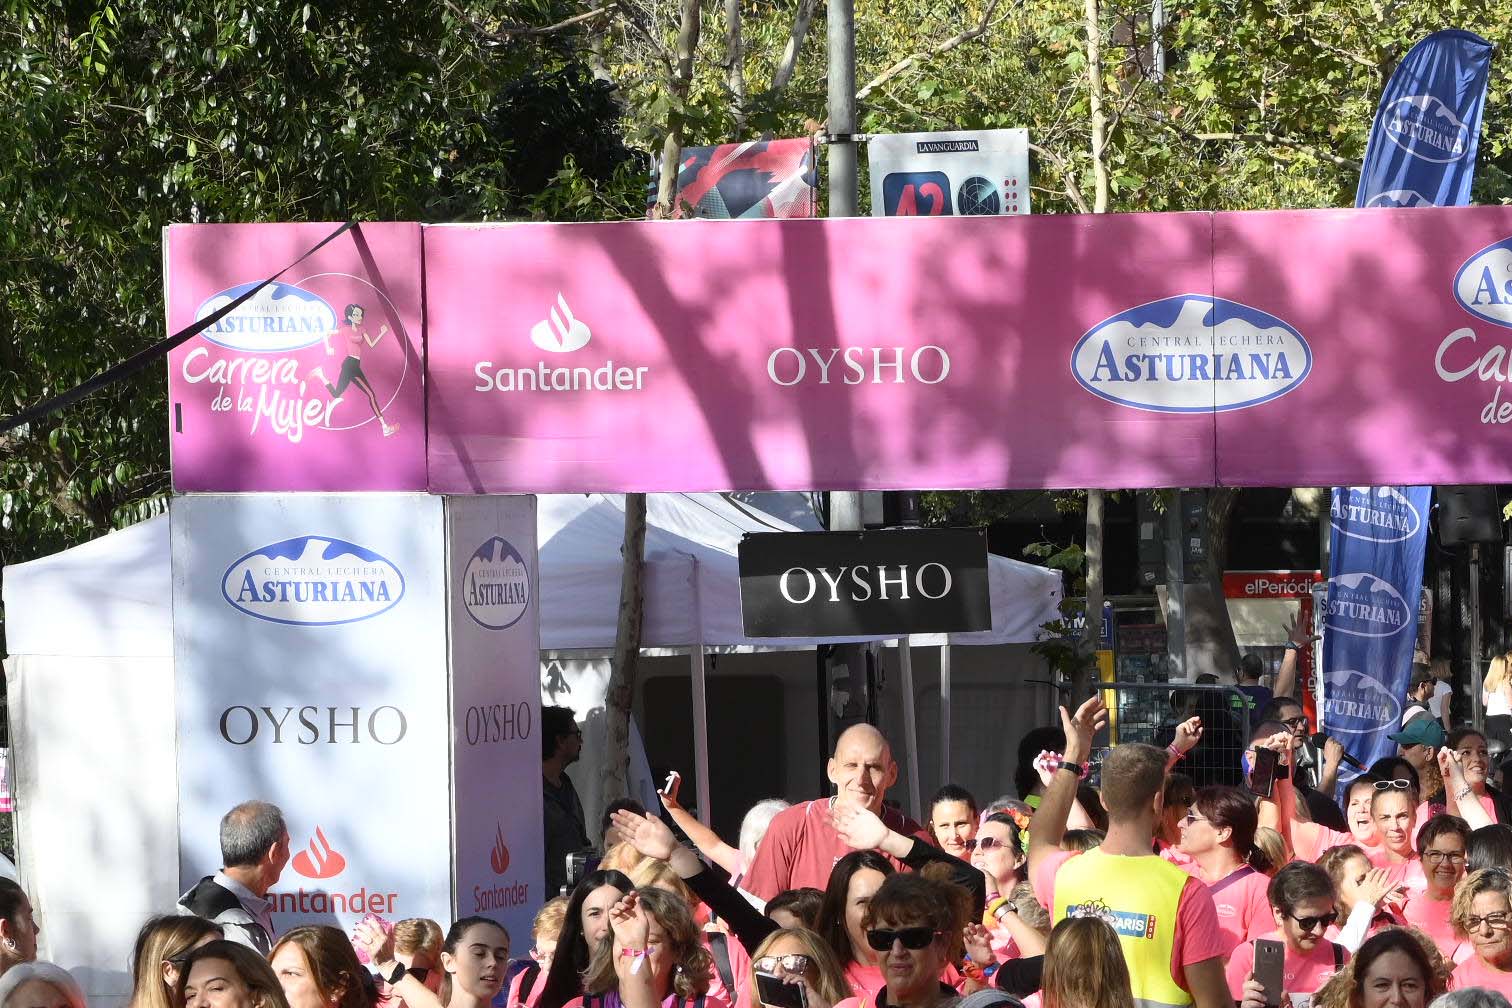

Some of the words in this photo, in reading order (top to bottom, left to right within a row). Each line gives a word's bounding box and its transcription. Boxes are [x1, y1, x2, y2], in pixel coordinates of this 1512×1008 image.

[1388, 108, 1463, 154] ASTURIANA
[205, 307, 325, 333] ASTURIANA
[1126, 335, 1202, 347] CENTRAL
[1210, 334, 1285, 347] LECHERA
[182, 347, 301, 385] Carrera
[474, 360, 649, 392] Santander
[767, 345, 950, 386] OYSHO
[1090, 339, 1294, 382] ASTURIANA
[211, 386, 232, 412] de
[237, 387, 254, 412] la
[250, 380, 344, 443] Mujer
[1330, 494, 1410, 533] ASTURIANA
[236, 569, 392, 603] ASTURIANA
[264, 567, 320, 576] CENTRAL
[328, 567, 385, 576] LECHERA
[468, 572, 526, 607] ASTURIANA
[779, 562, 953, 605] OYSHO
[219, 705, 408, 745] OYSHO
[466, 701, 532, 746] OYSHO
[1324, 699, 1391, 722] TURIANA
[265, 886, 398, 914] antander
[473, 882, 529, 912] Santander
